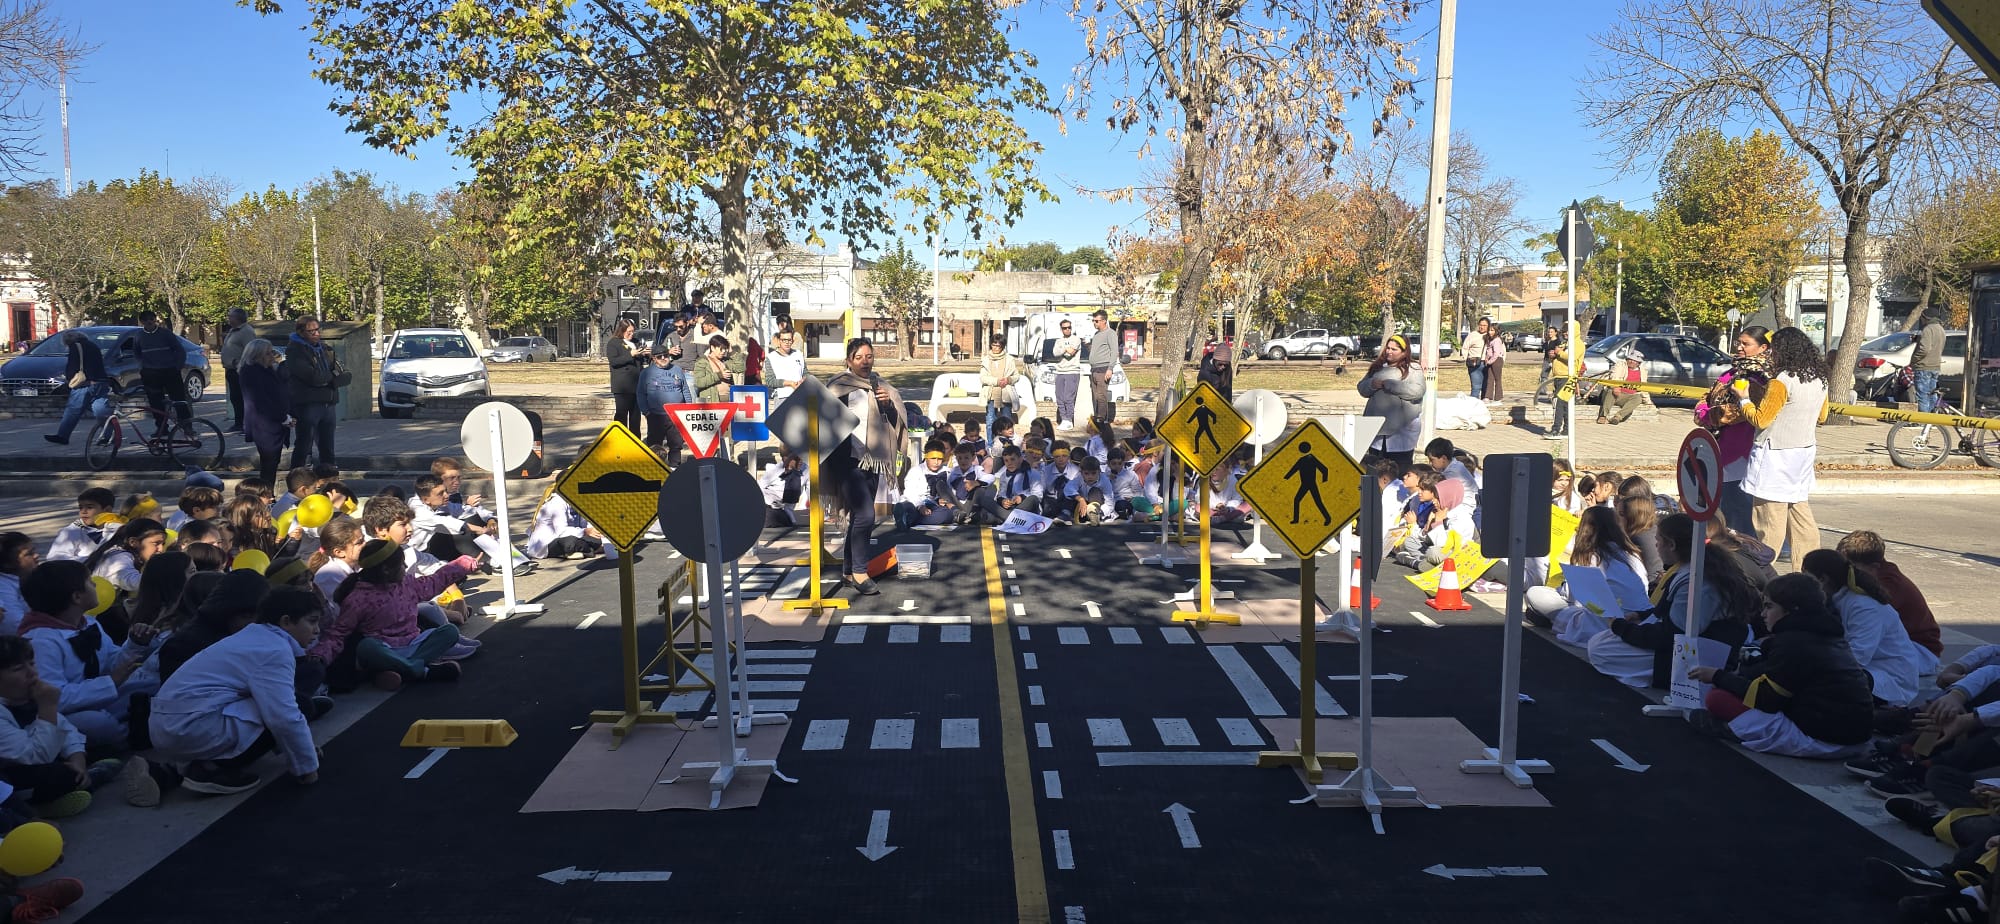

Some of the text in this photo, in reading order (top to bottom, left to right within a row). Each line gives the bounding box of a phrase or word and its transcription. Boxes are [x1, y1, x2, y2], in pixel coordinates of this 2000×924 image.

[685, 413, 719, 421] CEDA EL
[691, 423, 714, 431] PASO
